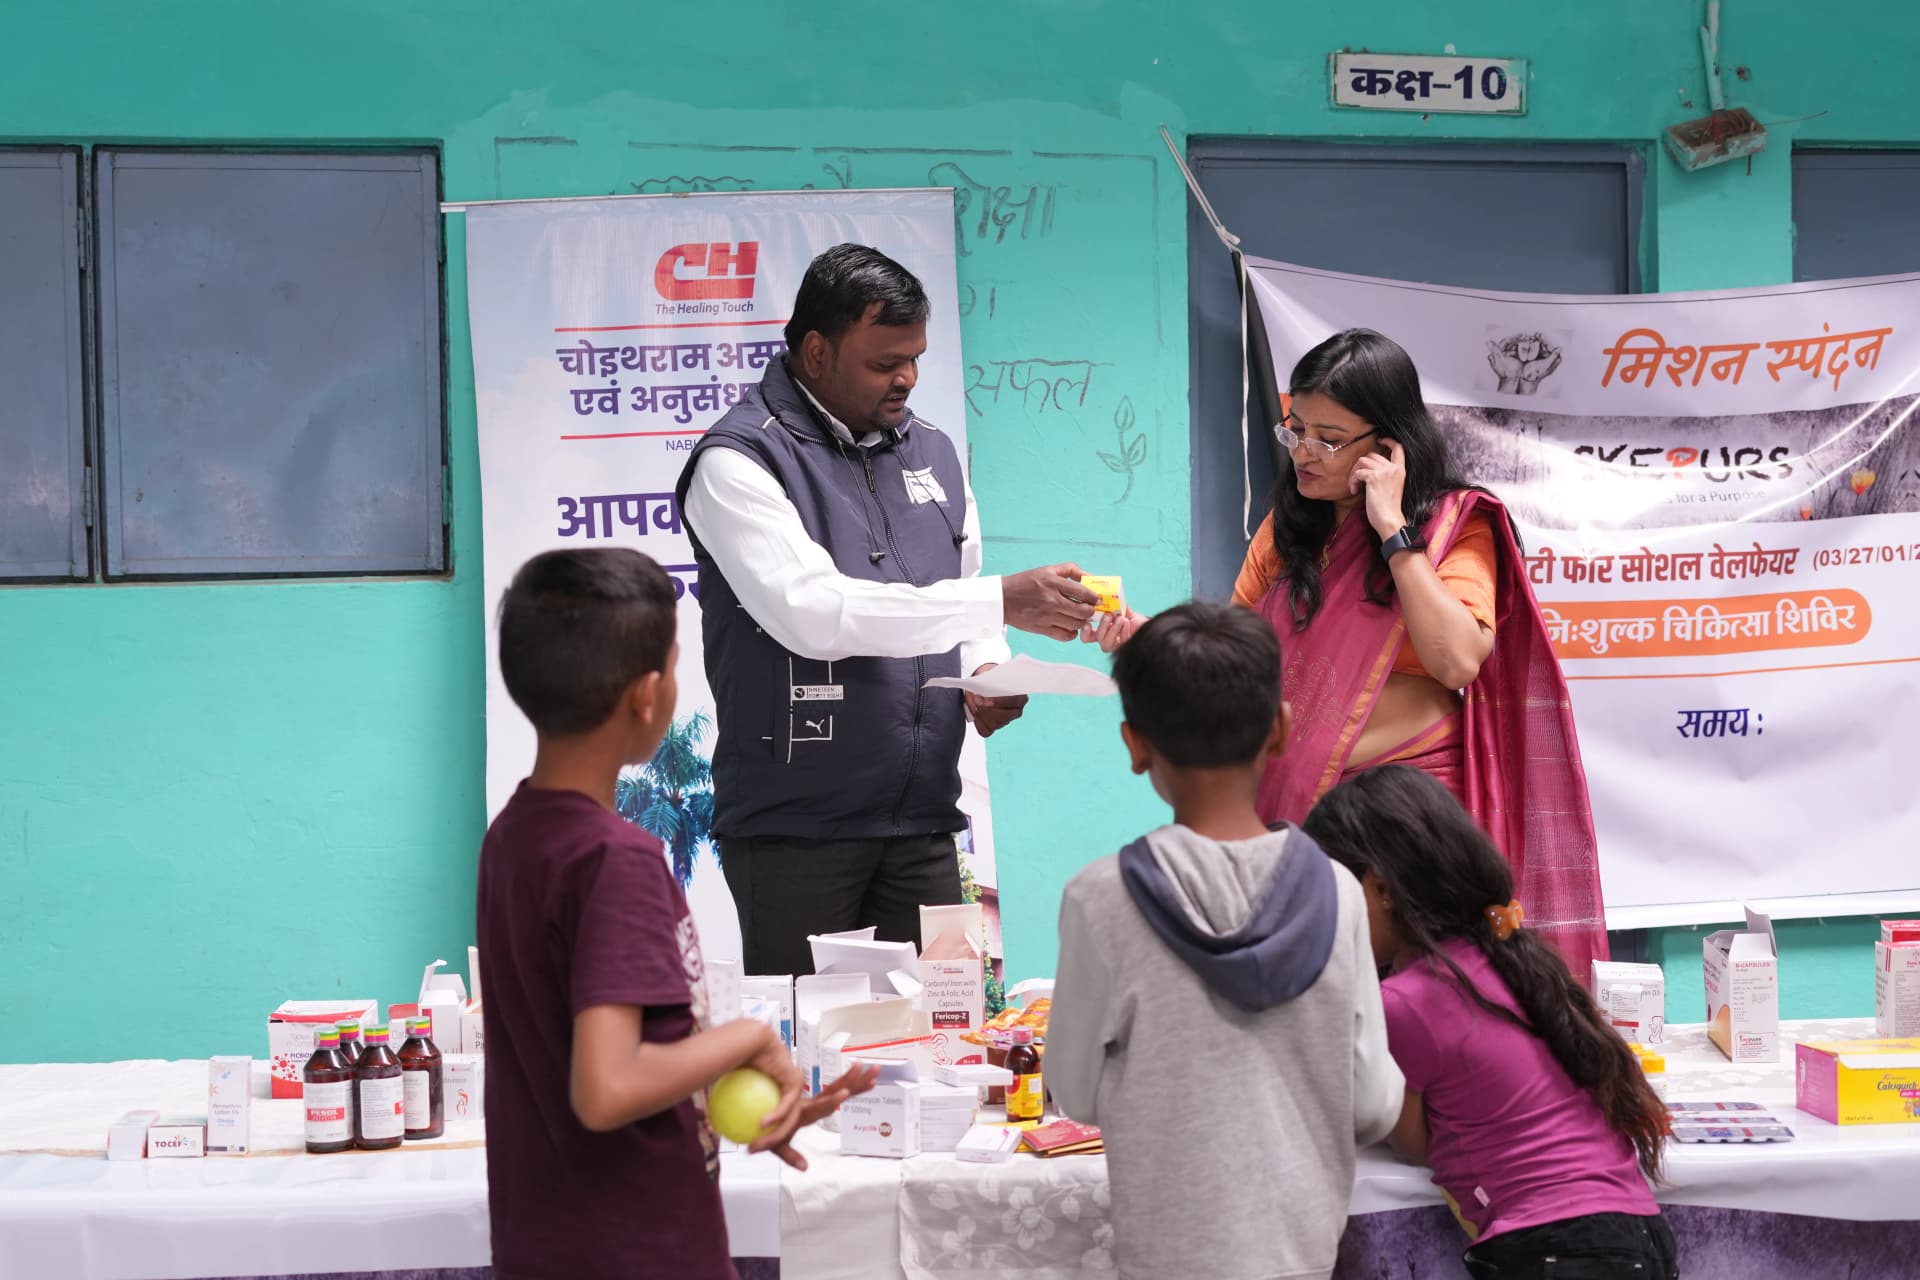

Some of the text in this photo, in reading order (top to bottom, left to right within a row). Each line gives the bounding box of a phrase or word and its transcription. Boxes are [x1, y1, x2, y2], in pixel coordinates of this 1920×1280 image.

[1350, 64, 1507, 101] कक्ष-10
[655, 300, 754, 315] The Healing Touch
[556, 339, 713, 378] चोइथराम
[1601, 322, 1893, 392] मिशन स्पंदन
[570, 379, 621, 416] एवं
[964, 357, 1098, 417] सफल
[1619, 546, 1704, 582] सोशल
[1708, 541, 1800, 579] वेलफेयर
[1662, 604, 1771, 641] चिकित्सा
[1775, 596, 1857, 635] शिविर
[1676, 708, 1750, 738] समय
[927, 990, 940, 998] Zinc
[961, 989, 974, 997] Acid
[938, 1000, 964, 1008] Capsules
[935, 1012, 967, 1020] Fericop-Z
